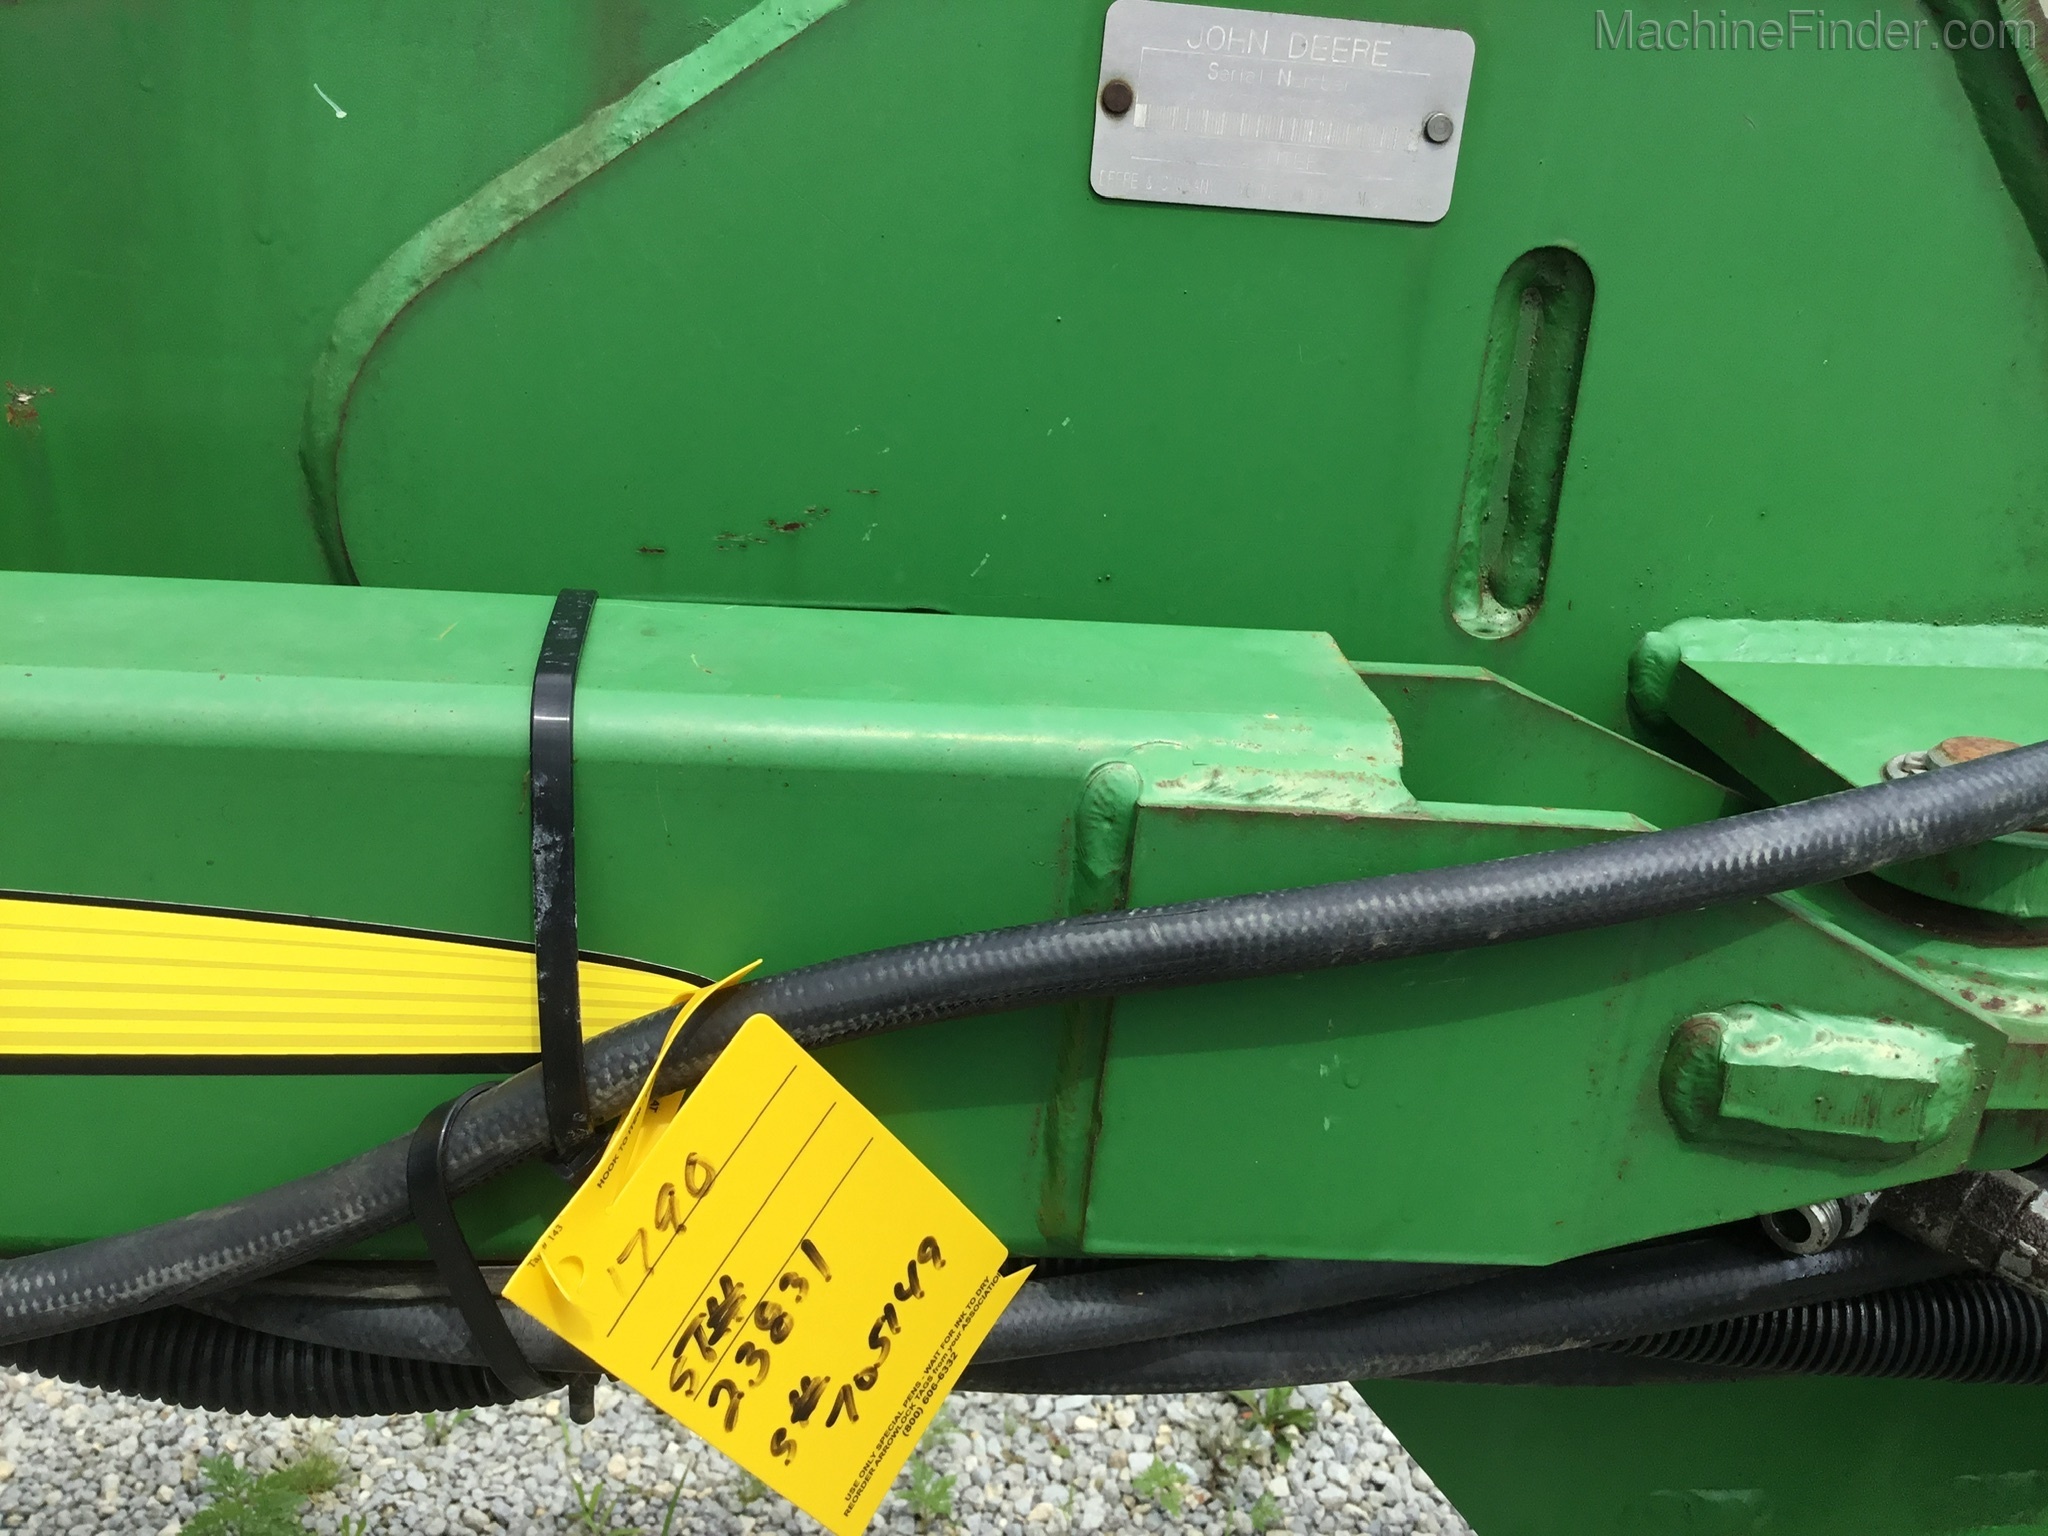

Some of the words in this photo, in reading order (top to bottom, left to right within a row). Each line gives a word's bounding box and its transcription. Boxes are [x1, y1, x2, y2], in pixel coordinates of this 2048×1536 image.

[1187, 26, 1268, 55] JOHN
[1288, 32, 1391, 67] DEERE
[1208, 62, 1263, 84] Serial
[597, 1154, 619, 1189] HOOK
[618, 1136, 628, 1151] TO
[628, 1106, 642, 1135] ITEM
[548, 1224, 563, 1241] 143
[608, 1152, 715, 1293] 1790
[708, 1239, 831, 1432] 23831
[843, 1467, 876, 1517] REORDER
[875, 1402, 916, 1467] ARROWLOCK
[914, 1375, 933, 1400] TAGS
[932, 1353, 948, 1374] from
[947, 1331, 962, 1353] your
[845, 1479, 860, 1501] USE
[859, 1451, 876, 1478] ONLY
[876, 1410, 904, 1451] SPECIAL
[903, 1381, 921, 1408] PENS
[923, 1350, 941, 1374] WAIT
[940, 1329, 956, 1350] FOR
[954, 1311, 967, 1329] INK
[965, 1297, 976, 1310] TO
[975, 1276, 989, 1297] DRY
[902, 1407, 924, 1437] (800)
[922, 1351, 958, 1405] 606-6332
